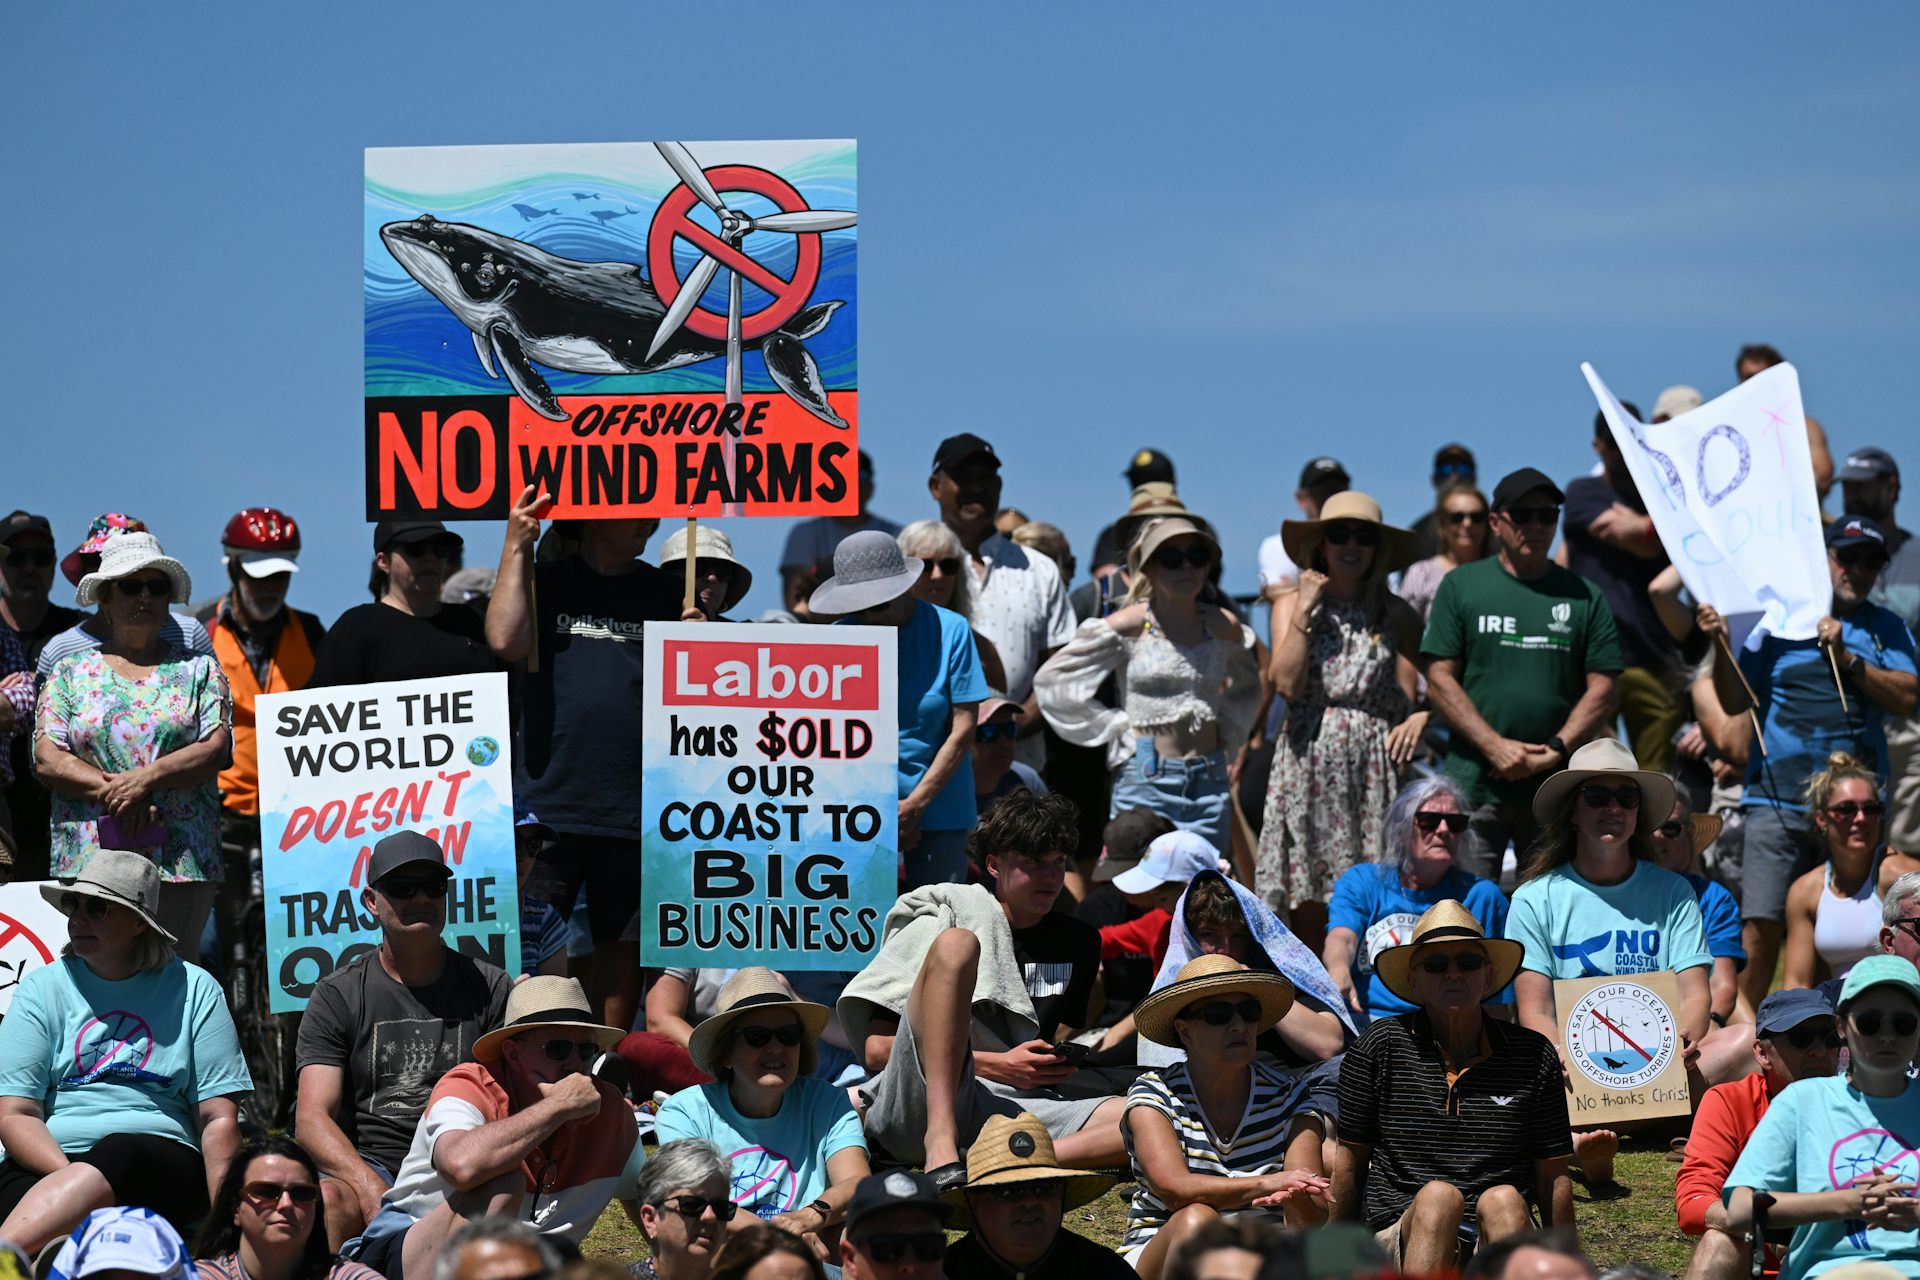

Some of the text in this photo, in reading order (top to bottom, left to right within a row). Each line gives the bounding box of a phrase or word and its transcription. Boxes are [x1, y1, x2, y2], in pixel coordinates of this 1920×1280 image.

[571, 401, 770, 437] OFFSHORE
[378, 409, 496, 511] NO
[518, 441, 850, 507] WIND FARMS
[1478, 615, 1517, 635] IRE
[675, 647, 863, 701] Labor
[275, 690, 474, 738] SAVE THE
[669, 710, 873, 762] has $OLD
[284, 733, 454, 777] WORLD
[727, 765, 814, 797] OUR
[279, 770, 471, 852] DOESN'T
[659, 801, 882, 842] COAST TO
[692, 850, 849, 900] BIG
[447, 876, 497, 925] HE
[658, 902, 878, 953] BUSINESS
[1615, 929, 1660, 957] NO
[1615, 953, 1660, 969] COASTAL
[1572, 987, 1669, 1029] SAVE OUR OCEAN
[1572, 1035, 1672, 1085] NO OFFSHORE TURBINES
[1576, 1081, 1689, 1111] No thanks Chris!
